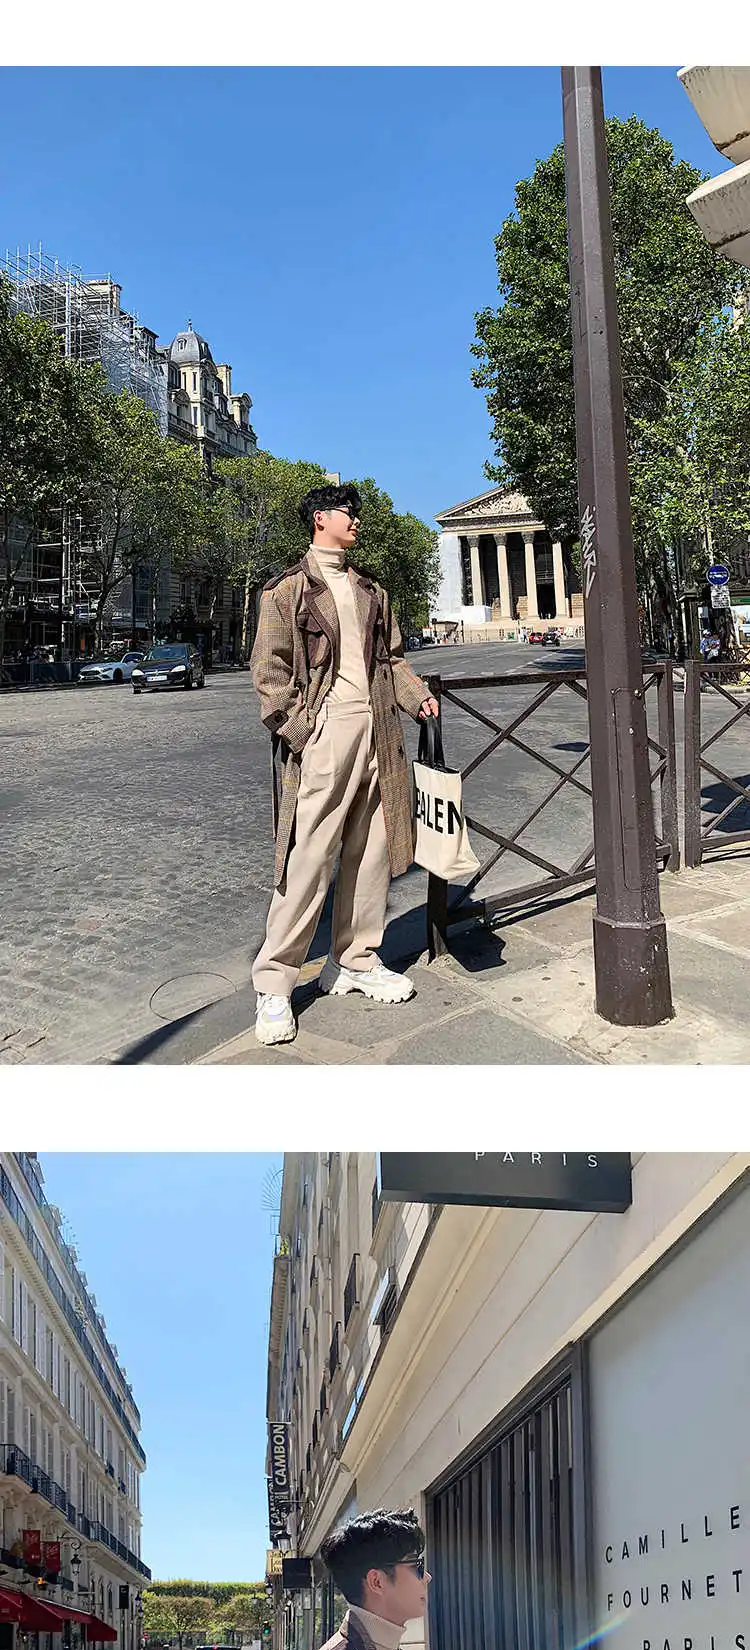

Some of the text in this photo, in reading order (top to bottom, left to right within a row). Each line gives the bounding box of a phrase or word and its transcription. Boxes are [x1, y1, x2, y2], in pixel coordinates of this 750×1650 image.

[475, 1151, 599, 1168] PARIS
[273, 1424, 287, 1486] CAMBON
[605, 1505, 740, 1564] CAMILLE
[607, 1569, 743, 1611] FOURNET
